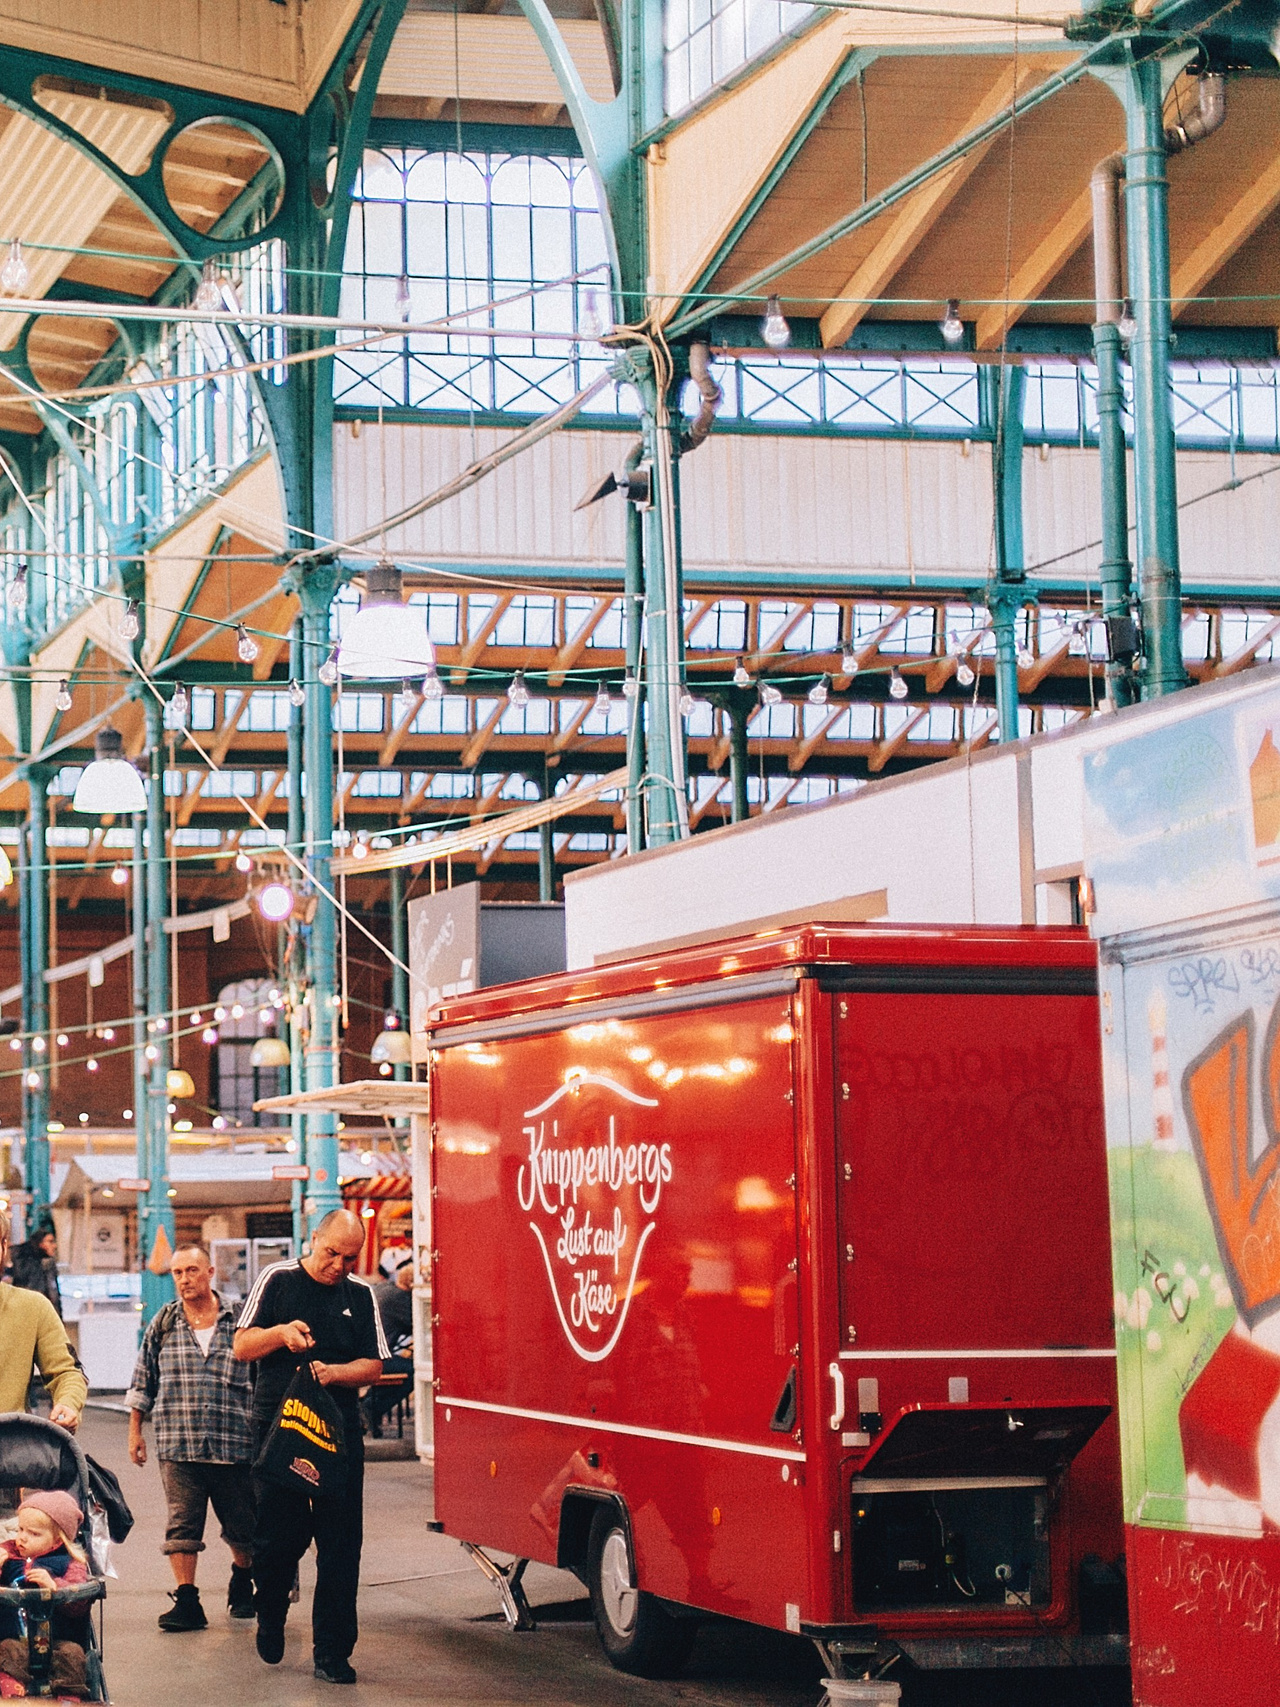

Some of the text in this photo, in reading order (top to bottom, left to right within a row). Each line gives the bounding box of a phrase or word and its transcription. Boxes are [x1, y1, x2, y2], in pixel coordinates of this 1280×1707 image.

[517, 1115, 672, 1214] Knippenbergs
[557, 1206, 627, 1275] Lust auf
[570, 1269, 617, 1333] Käse
